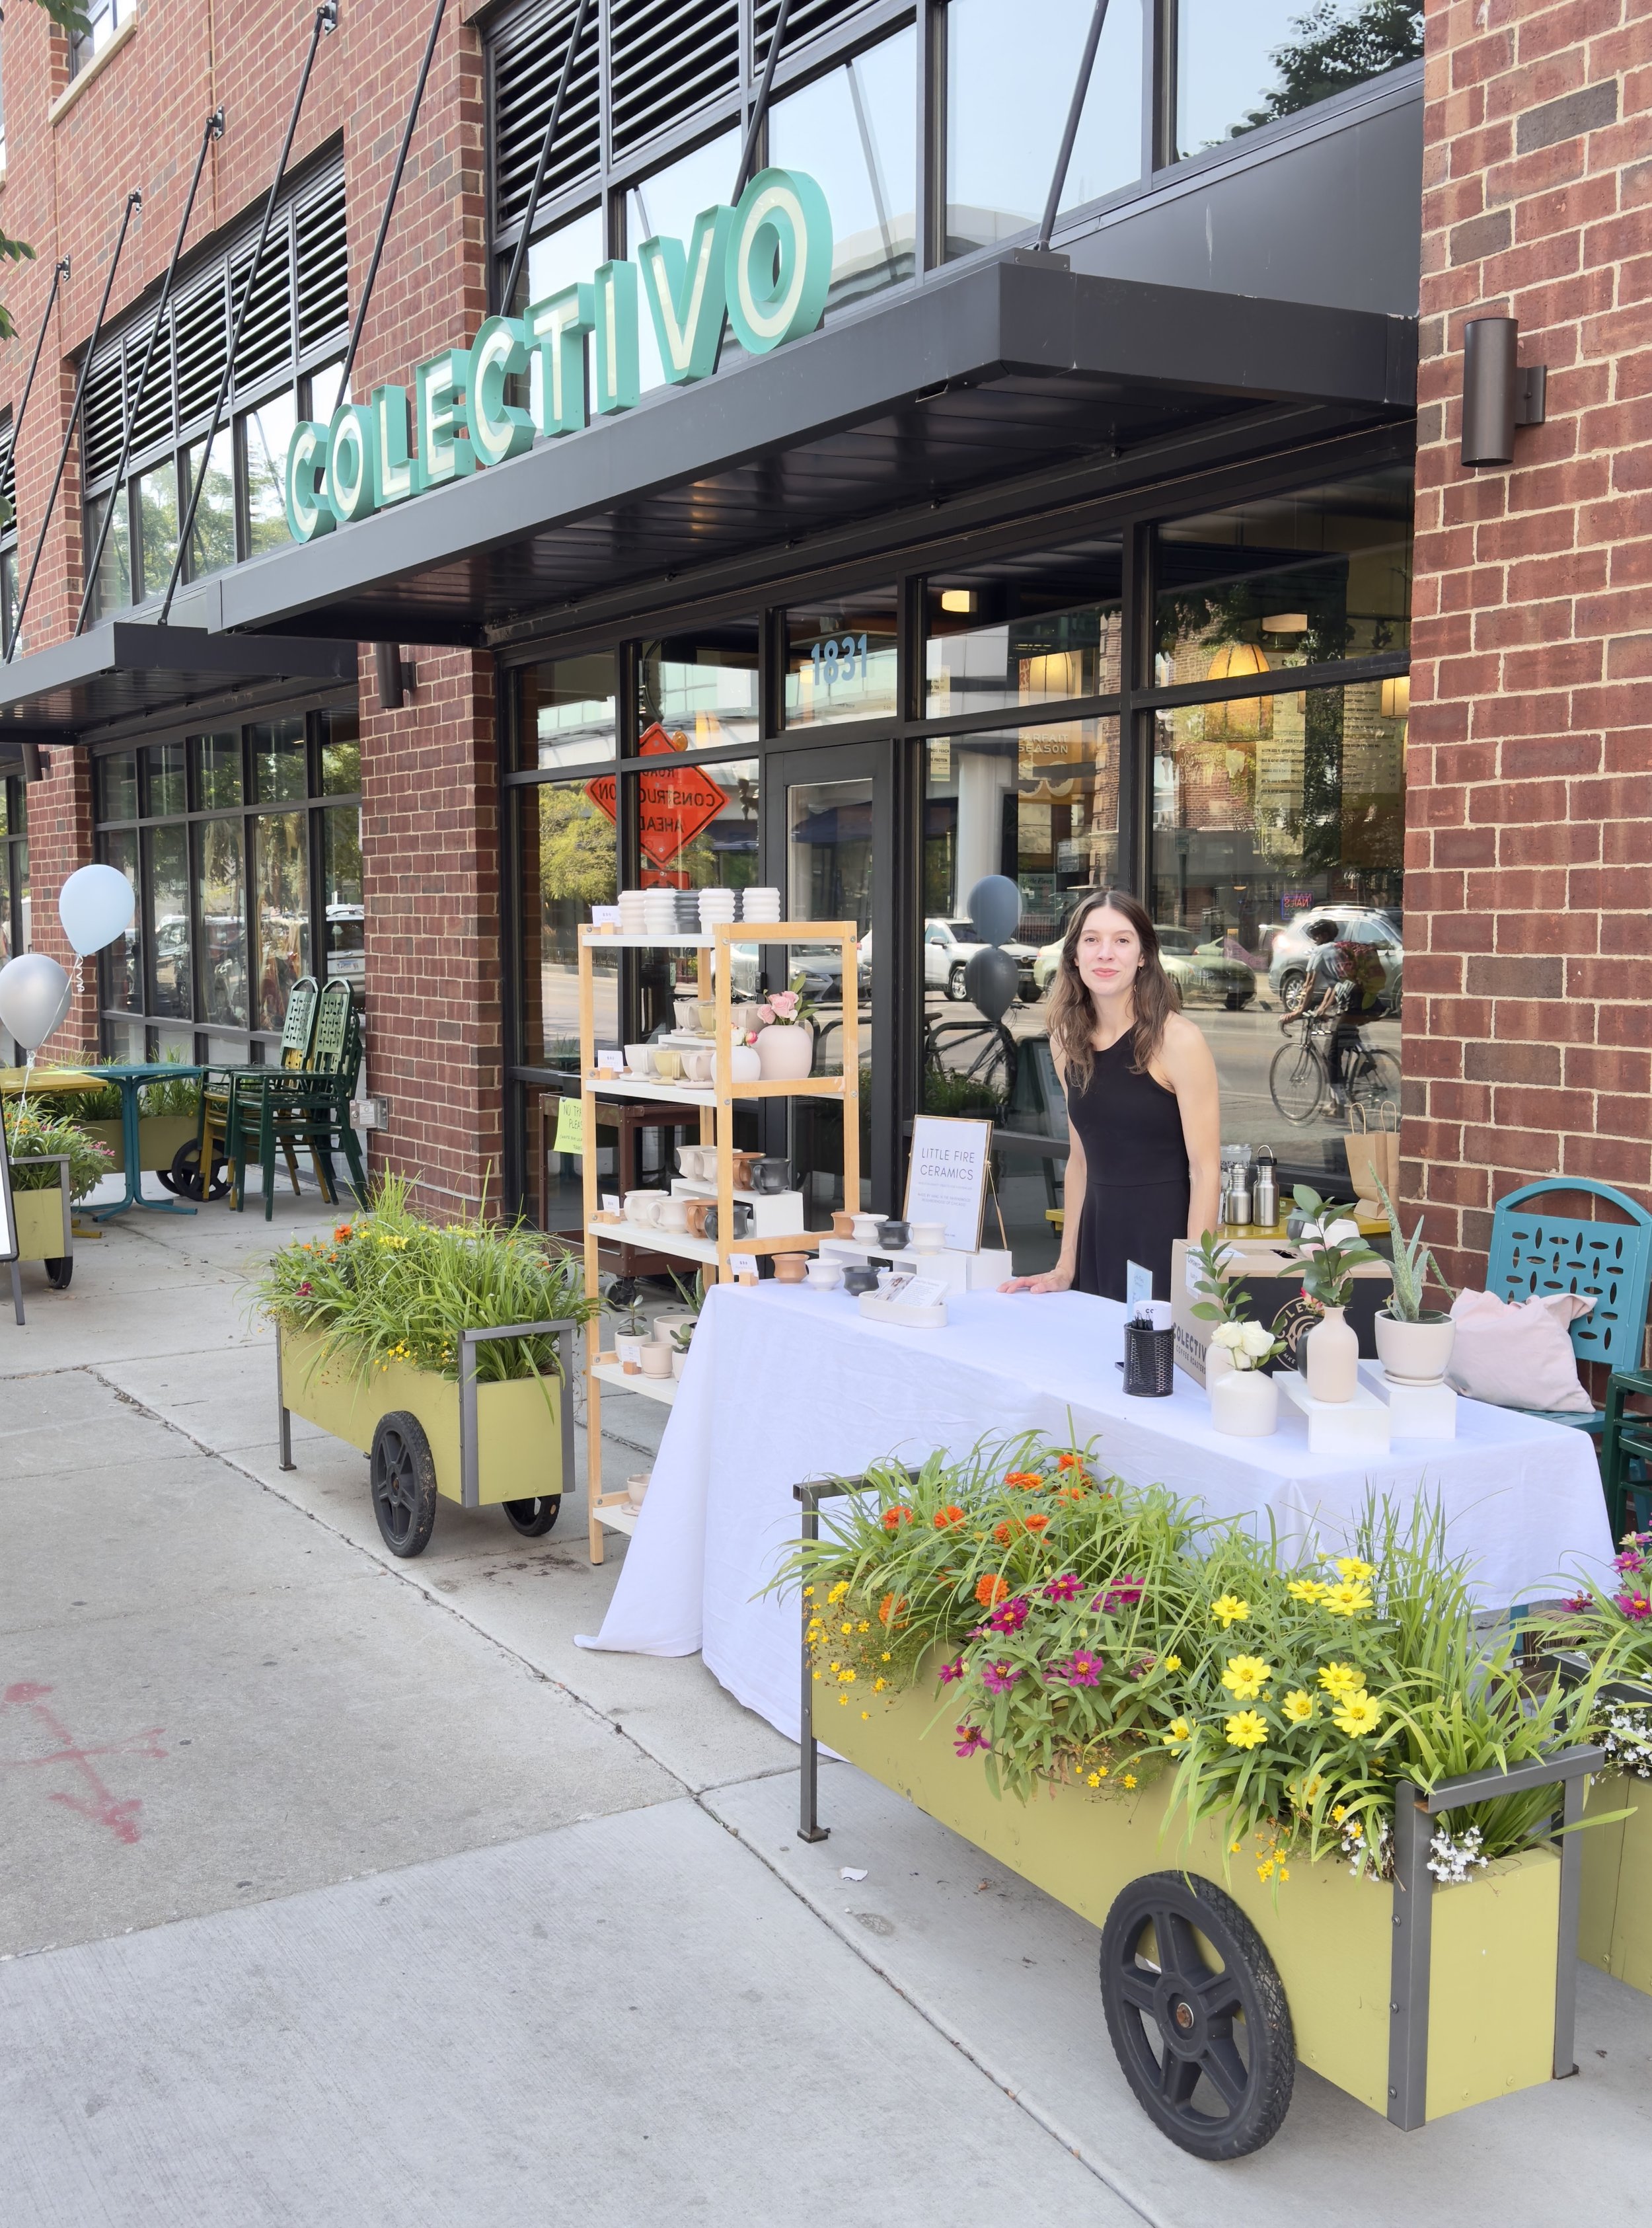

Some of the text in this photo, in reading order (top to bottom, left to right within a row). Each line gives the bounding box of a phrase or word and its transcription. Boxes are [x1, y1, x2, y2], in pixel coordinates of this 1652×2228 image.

[285, 167, 833, 544] COLECTIVO
[811, 634, 867, 685] 1831
[1018, 732, 1069, 743] PARFAIT
[1018, 744, 1069, 754] SEASON
[563, 1104, 571, 1116] NO
[569, 1118, 583, 1131] PLEAS
[921, 1147, 975, 1163] LITTLE FIRE
[920, 1165, 974, 1181] CERAMICS
[1173, 1322, 1207, 1362] COLECTIV
[1176, 1344, 1189, 1361] COFFEE
[1283, 1352, 1296, 1364] MKE
